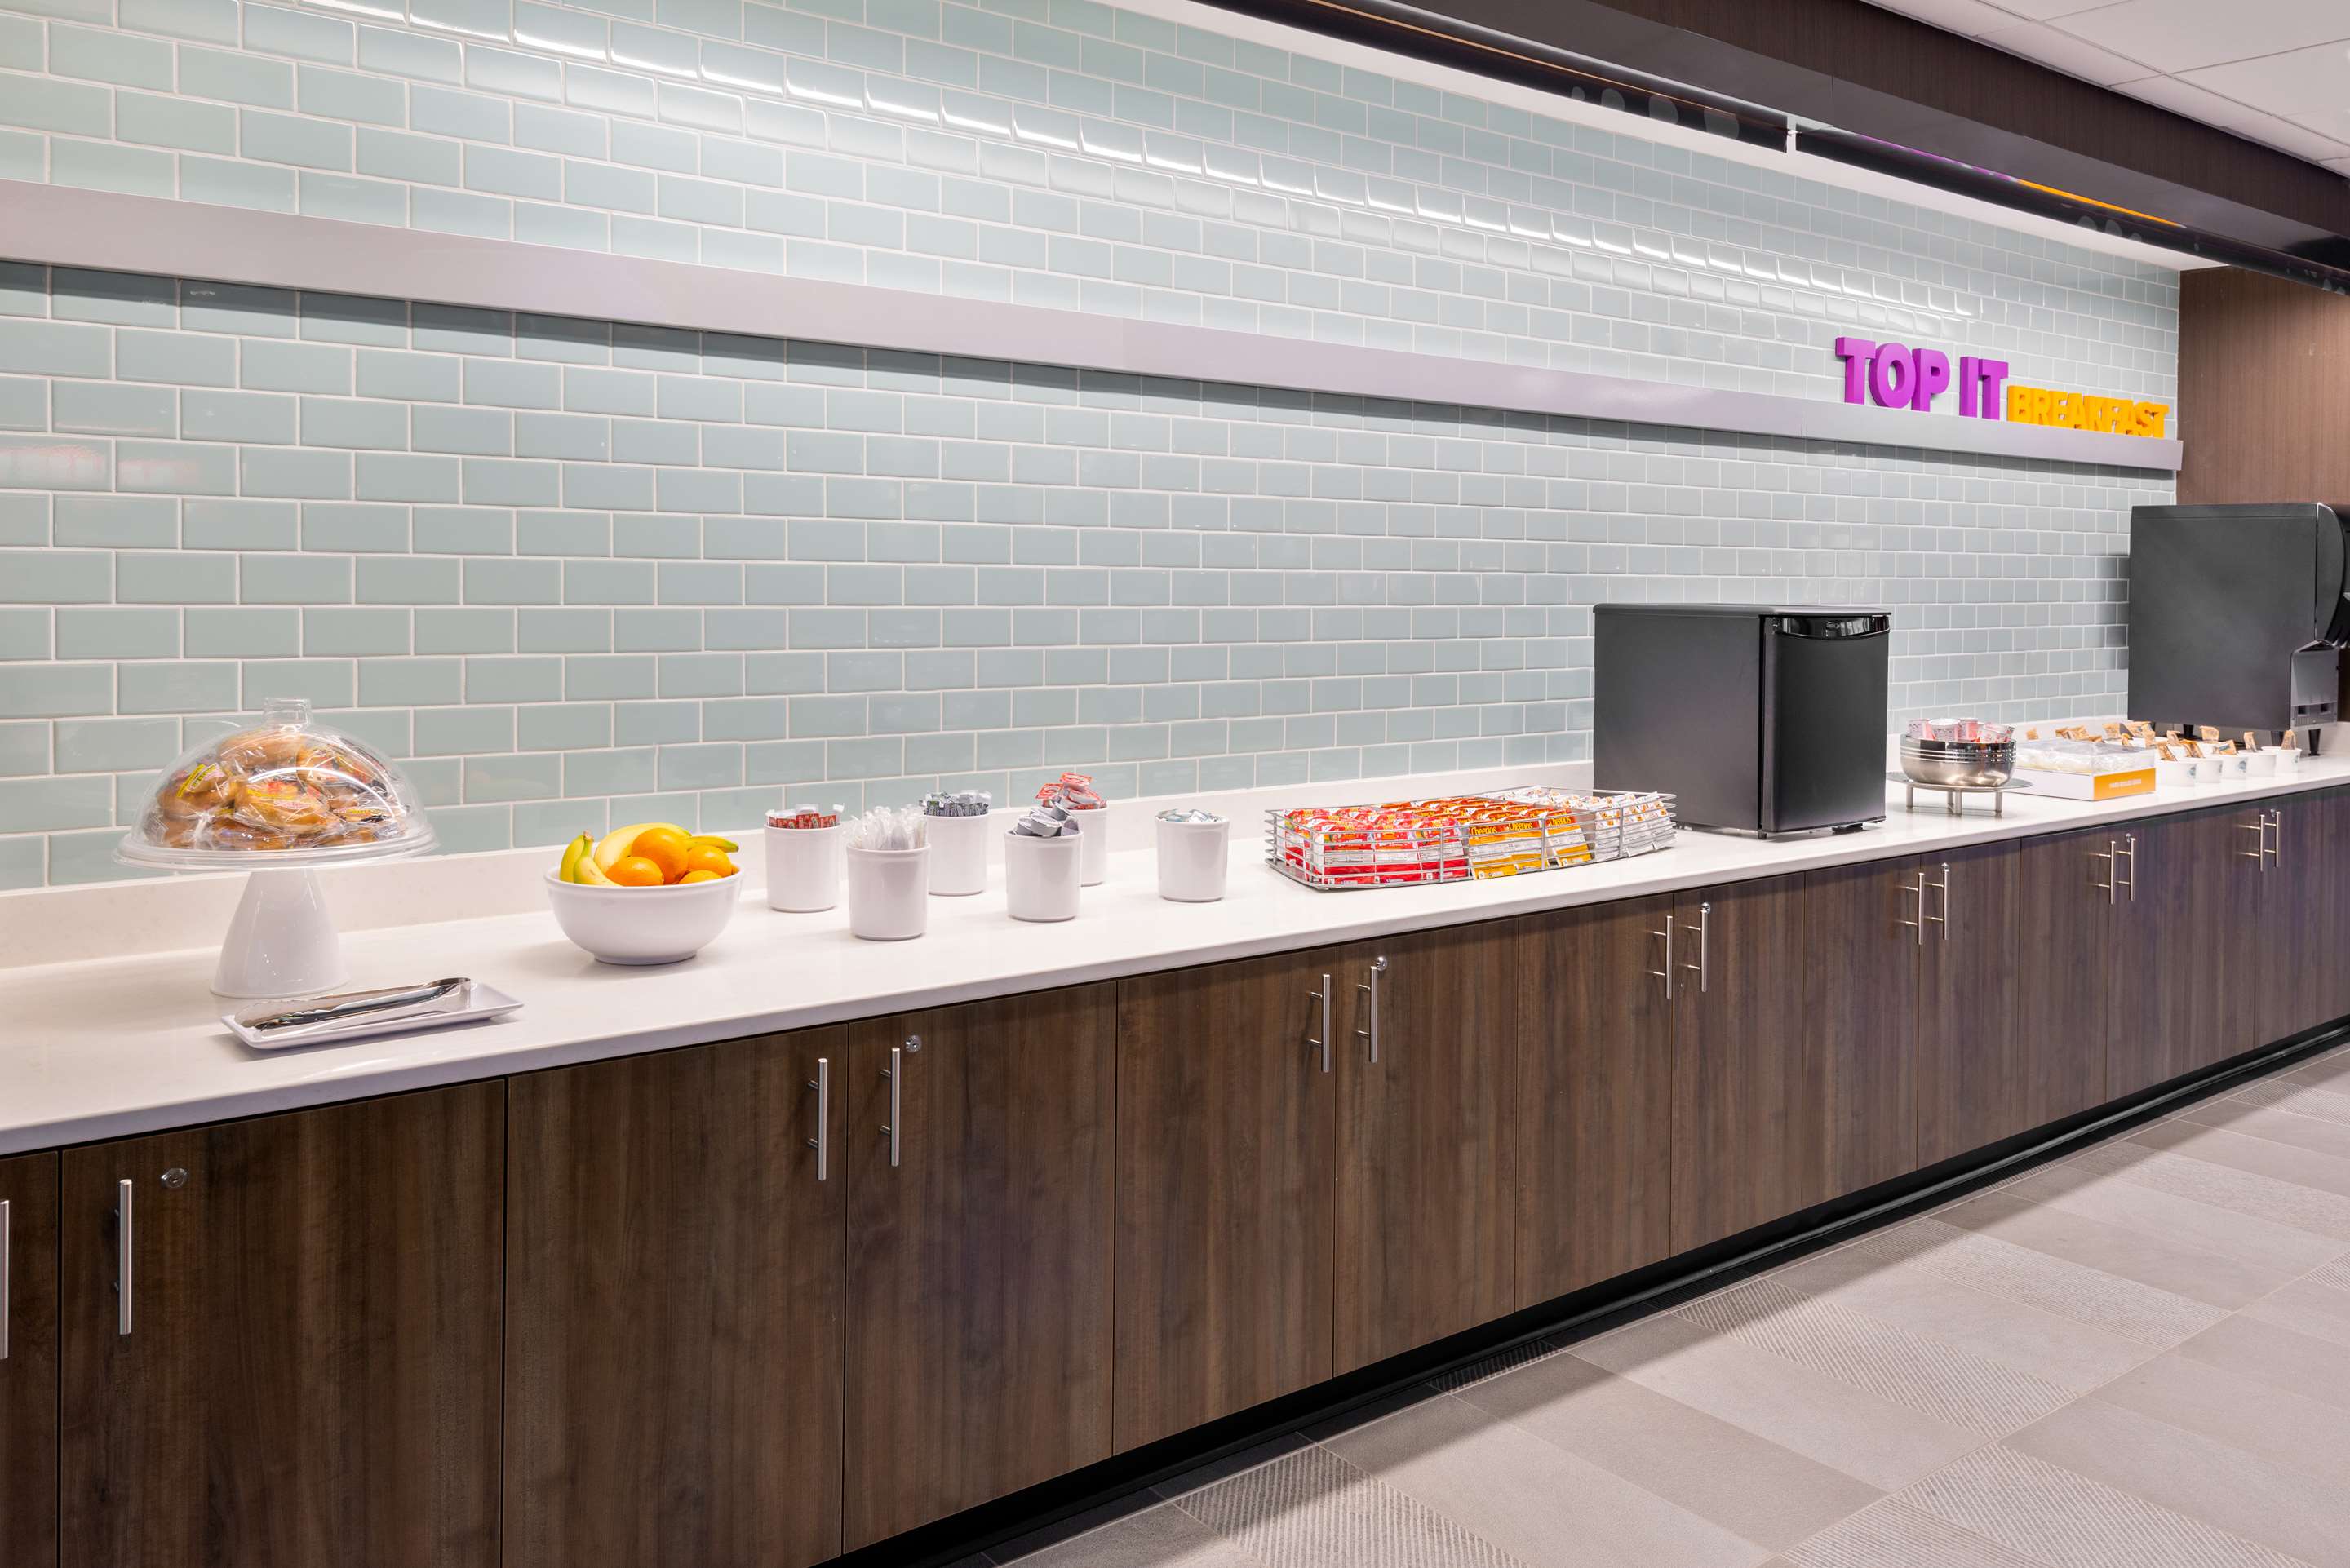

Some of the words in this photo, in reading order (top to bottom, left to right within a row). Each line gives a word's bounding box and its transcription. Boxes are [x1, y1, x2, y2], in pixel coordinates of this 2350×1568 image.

[1835, 336, 1951, 412] TOP
[1958, 356, 2009, 420] IT
[2006, 384, 2170, 439] BREAKFAST
[1470, 826, 1498, 835] Cheerios
